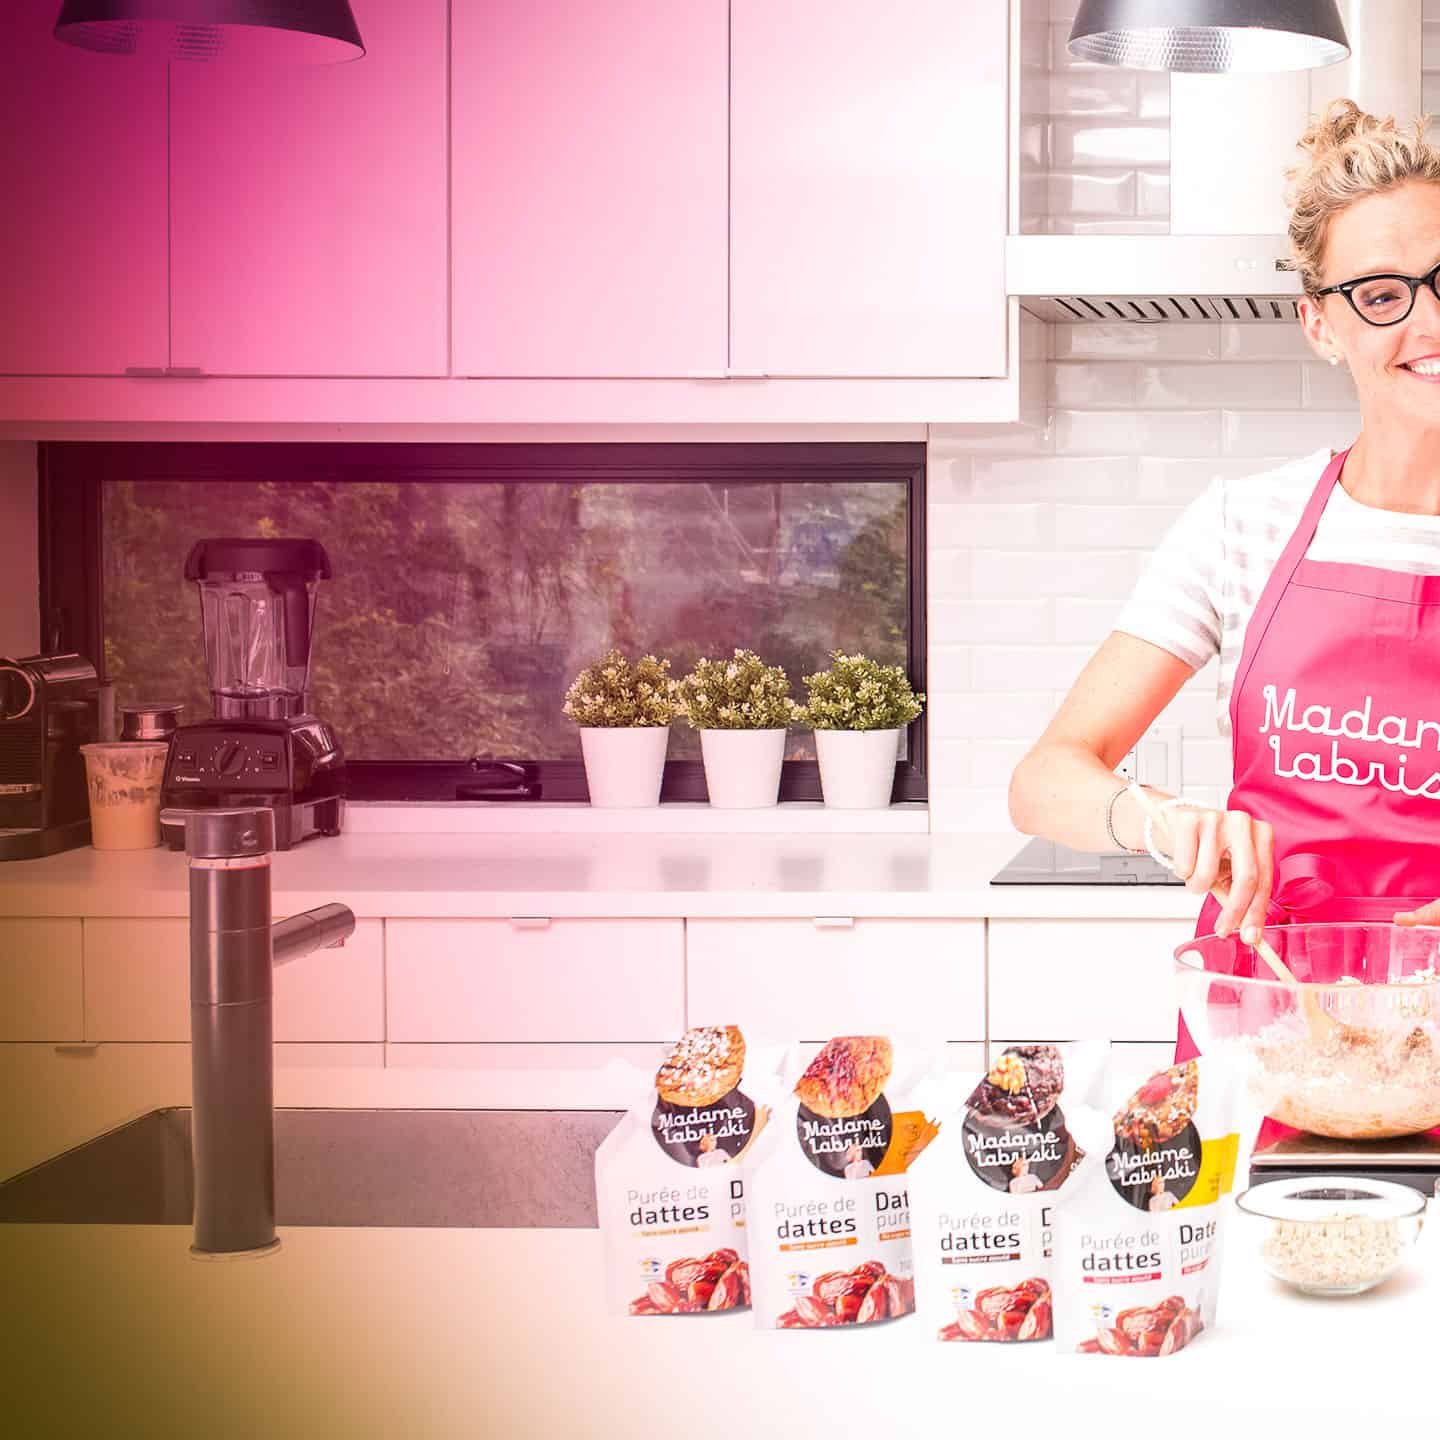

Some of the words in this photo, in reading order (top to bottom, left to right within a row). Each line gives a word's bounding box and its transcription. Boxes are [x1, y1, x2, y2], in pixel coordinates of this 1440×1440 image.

[657, 1107, 748, 1131] Madame
[803, 1117, 885, 1140] Madame
[662, 1119, 750, 1144] Labriski
[967, 1130, 1061, 1153] Madame
[808, 1132, 887, 1154] Labriski
[974, 1143, 1062, 1167] Labriski
[1112, 1147, 1194, 1172] Madame
[1118, 1161, 1196, 1187] Labriski
[627, 1186, 681, 1206] Purée
[686, 1185, 710, 1201] de
[630, 1205, 710, 1226] dattes
[774, 1199, 828, 1218] Purée
[833, 1196, 856, 1213] de
[777, 1218, 857, 1240] dattes
[938, 1211, 992, 1231] Purée
[998, 1209, 1021, 1227] de
[941, 1232, 1020, 1251] dattes
[1080, 1232, 1136, 1250] Purée
[1140, 1229, 1160, 1247] de
[1082, 1252, 1161, 1272] dattes
